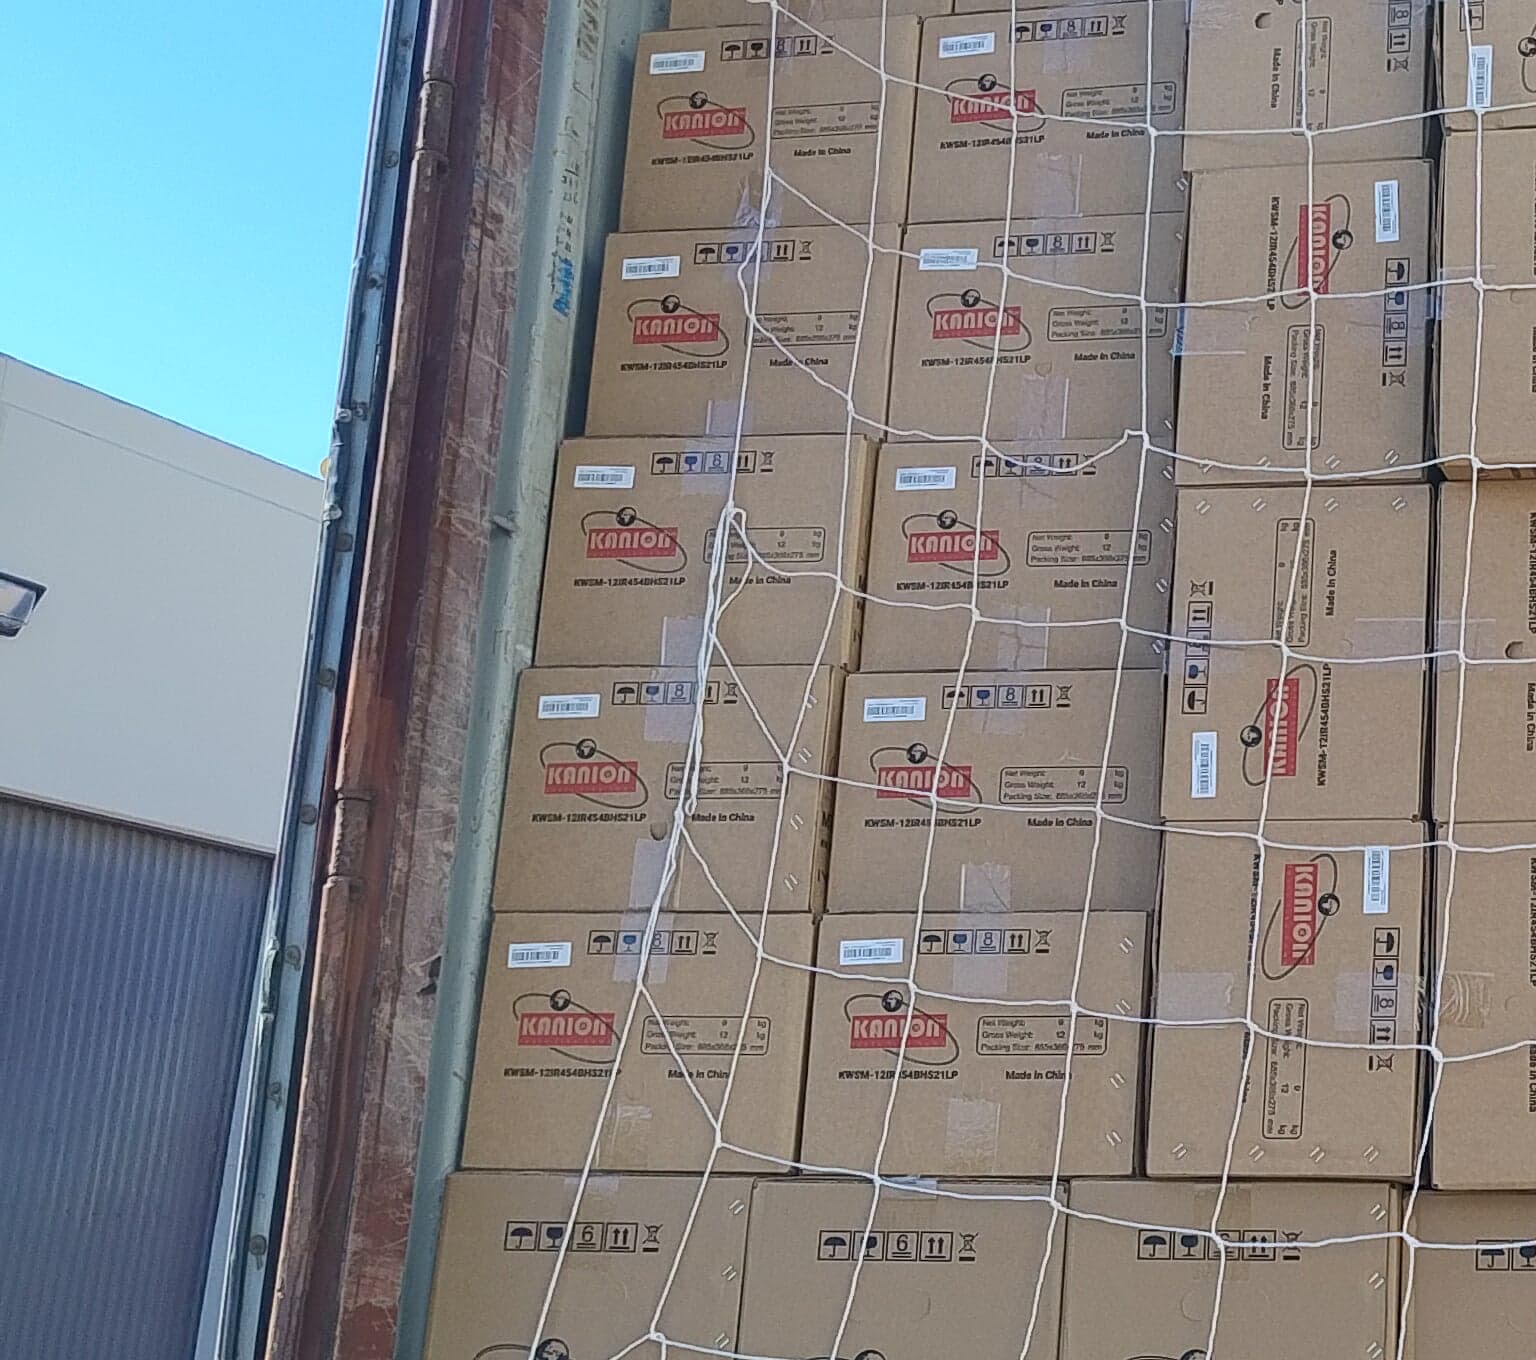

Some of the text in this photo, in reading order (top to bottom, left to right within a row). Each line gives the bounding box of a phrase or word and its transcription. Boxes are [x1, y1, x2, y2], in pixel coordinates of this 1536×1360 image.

[665, 110, 739, 132] KANION
[636, 316, 712, 336] KANION
[590, 531, 669, 549] KANION
[548, 765, 630, 786] KANION
[1291, 866, 1314, 956] KANION
[521, 1016, 606, 1036] KANION
